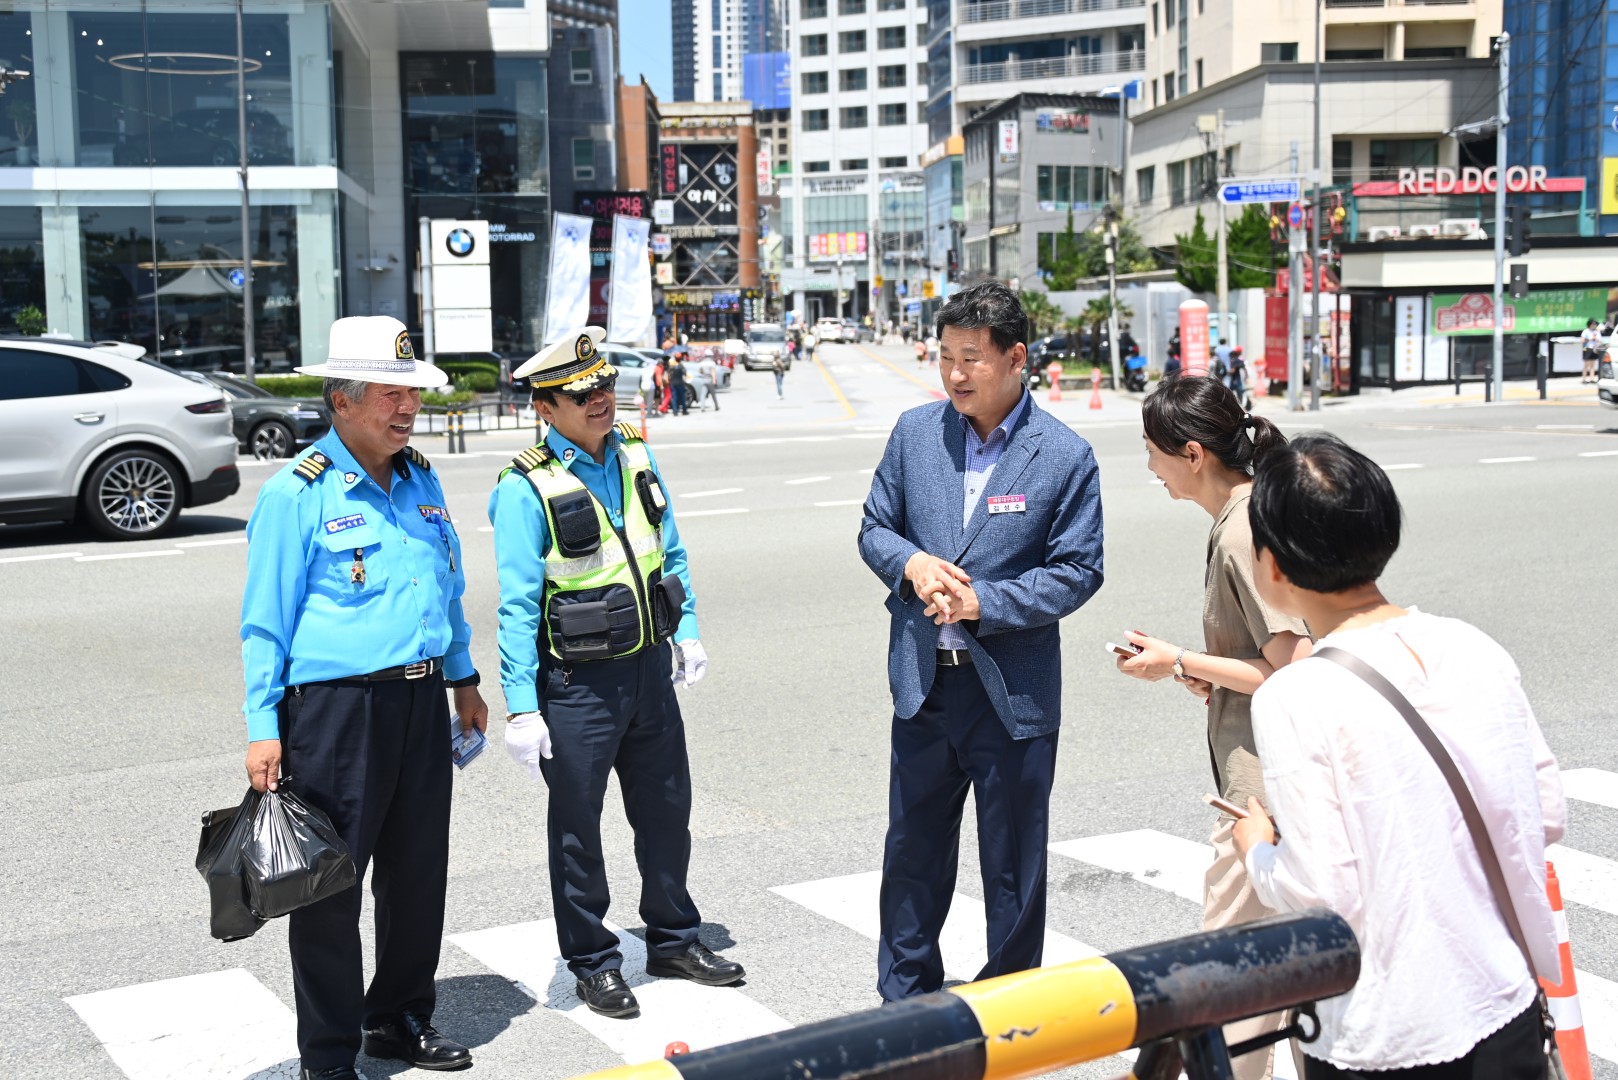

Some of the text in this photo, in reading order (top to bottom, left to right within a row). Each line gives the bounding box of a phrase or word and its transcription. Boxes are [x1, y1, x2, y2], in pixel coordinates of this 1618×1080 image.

[1397, 163, 1548, 196] RED DOOR
[488, 223, 507, 233] MW
